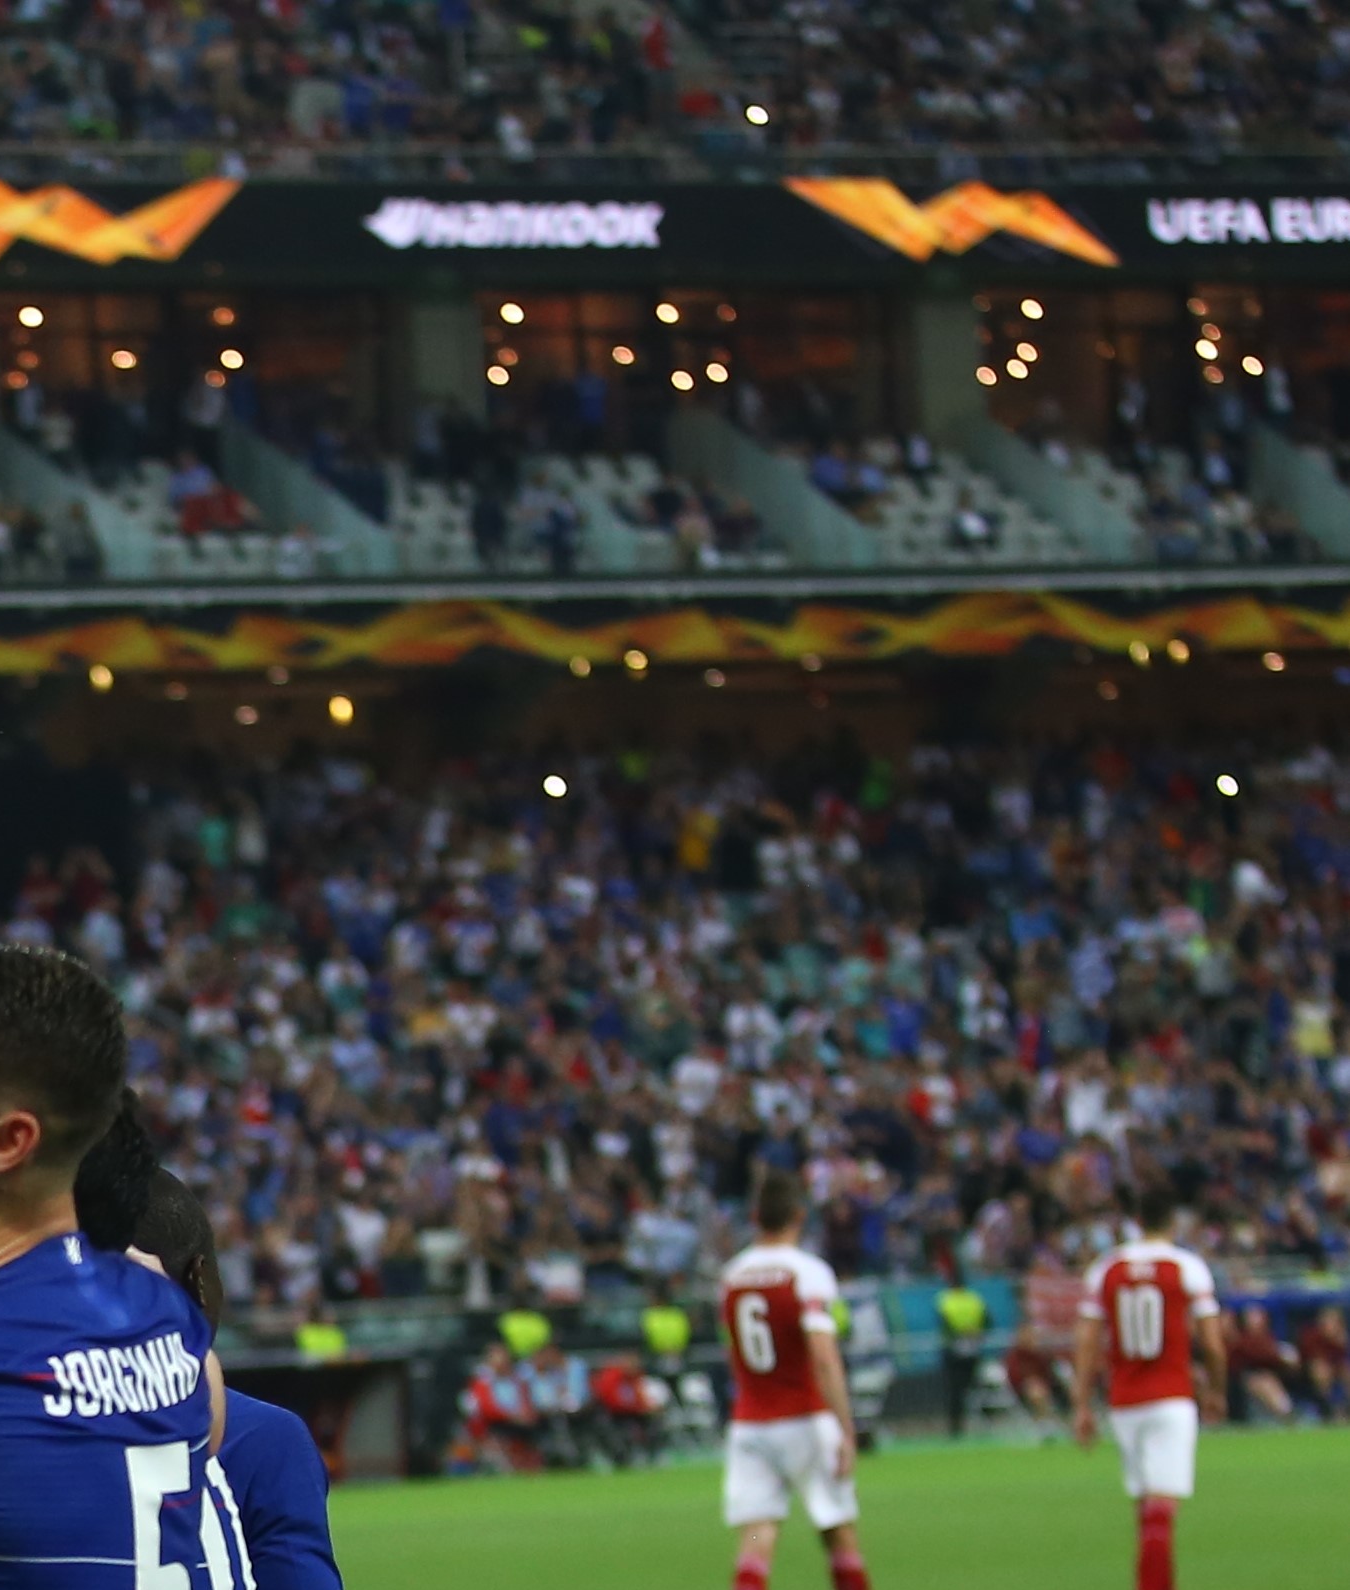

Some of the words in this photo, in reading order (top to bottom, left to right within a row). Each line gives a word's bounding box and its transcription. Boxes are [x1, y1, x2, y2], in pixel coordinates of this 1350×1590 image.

[1146, 196, 1272, 245] UEFA
[734, 1290, 777, 1374] 6
[1115, 1285, 1164, 1362] 10
[42, 1331, 201, 1418] JORGINHO
